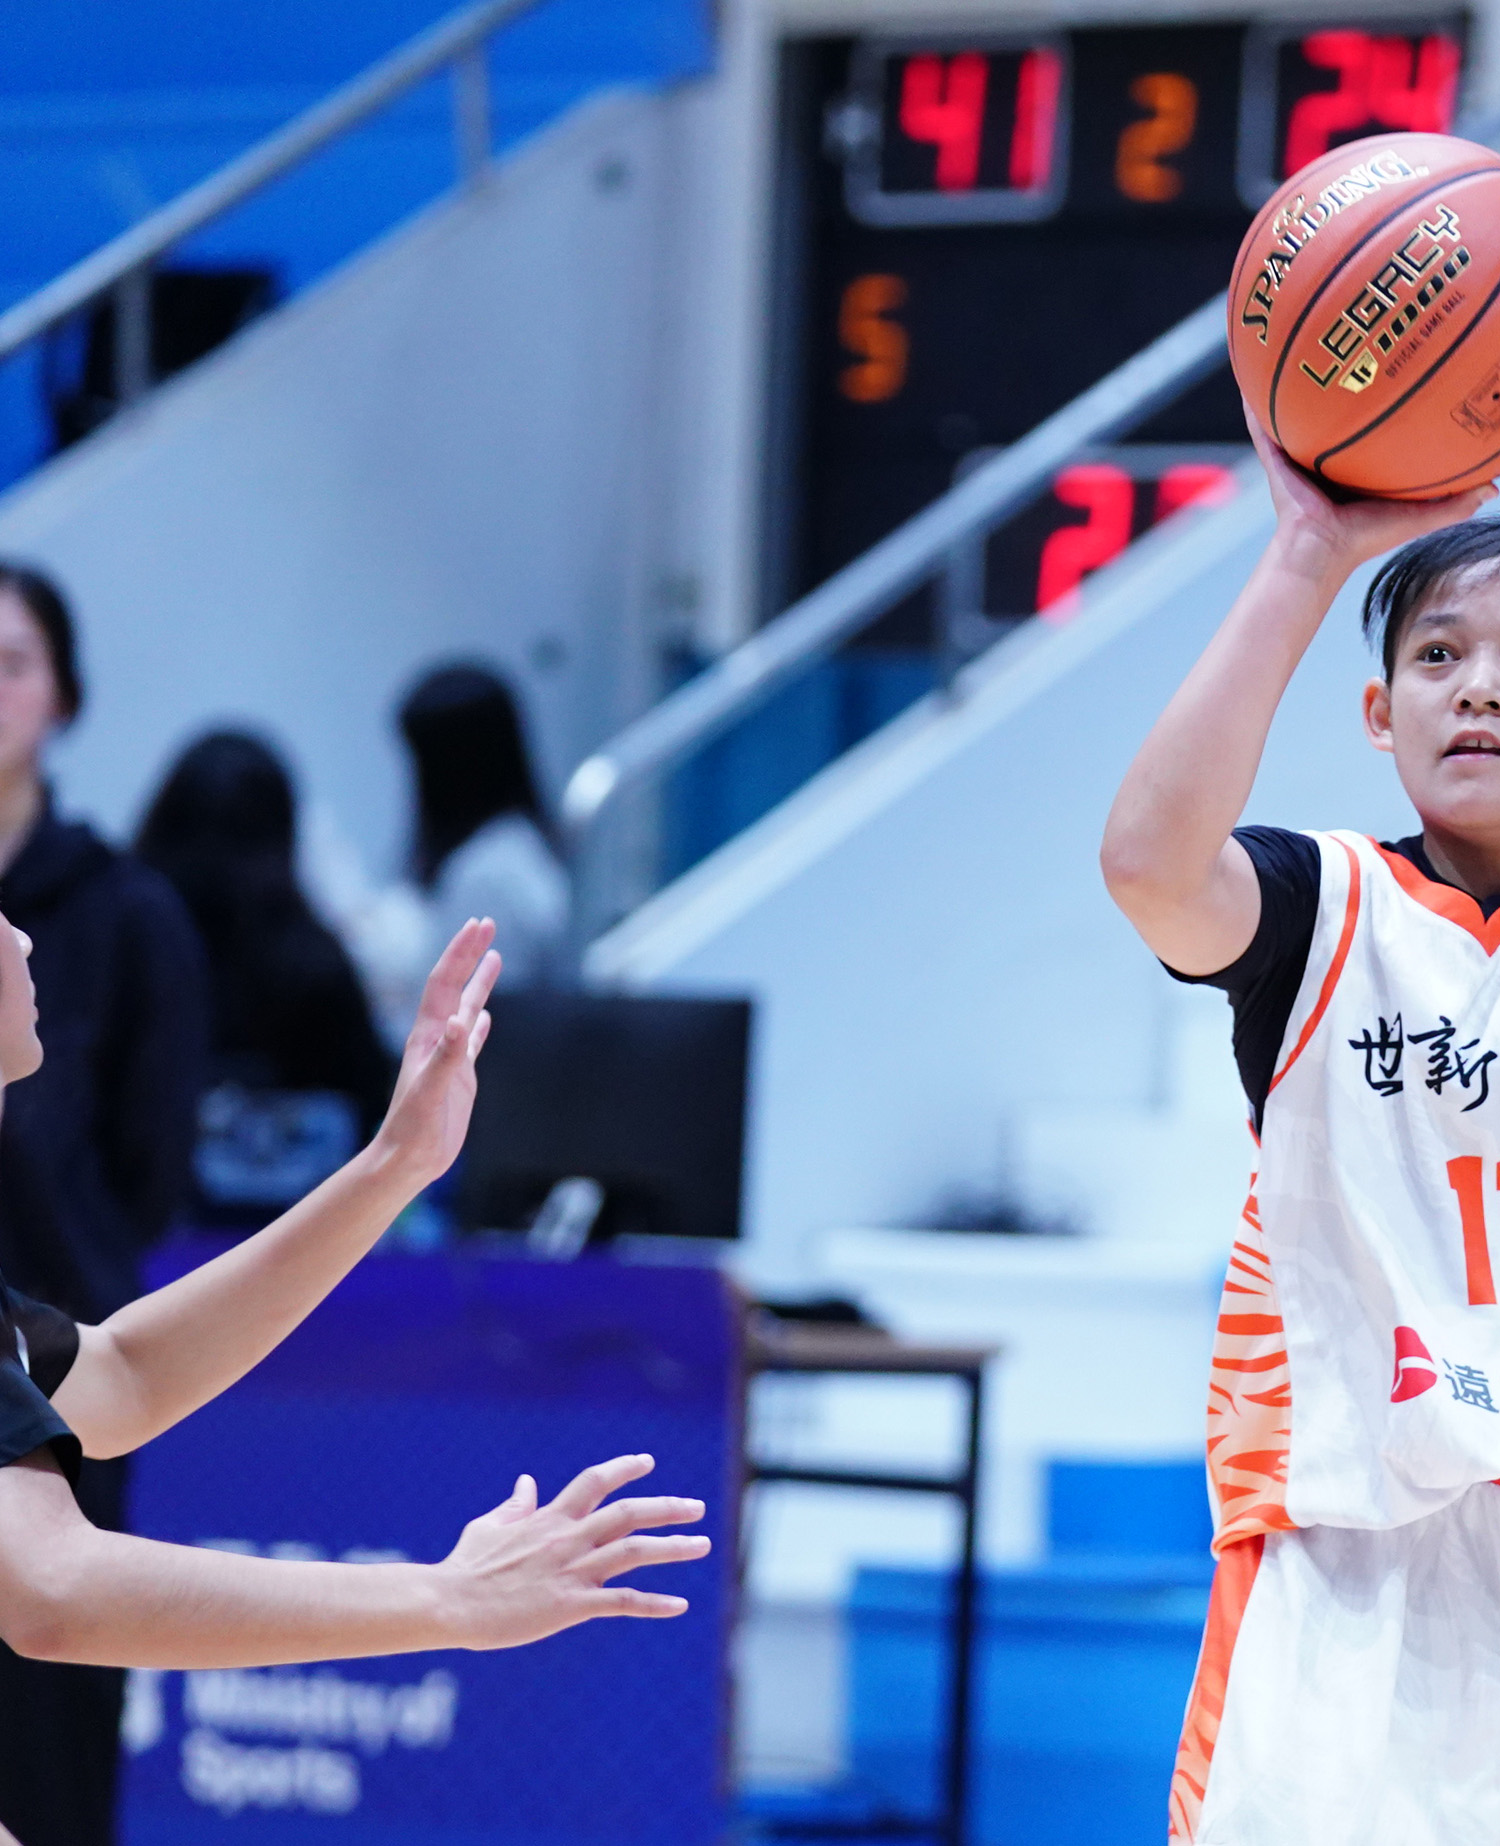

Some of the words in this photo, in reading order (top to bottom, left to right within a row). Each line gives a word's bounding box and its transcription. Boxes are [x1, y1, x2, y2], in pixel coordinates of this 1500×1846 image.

[900, 50, 1063, 193] 41
[1115, 72, 1199, 202] 2
[1285, 30, 1460, 180] 24
[1241, 149, 1419, 346] SPALDING
[1299, 203, 1461, 391] LEGACY
[838, 273, 909, 402] 5
[1384, 337, 1421, 379] OFFICIAL
[1420, 312, 1444, 339] GAME
[1441, 290, 1466, 314] BALL
